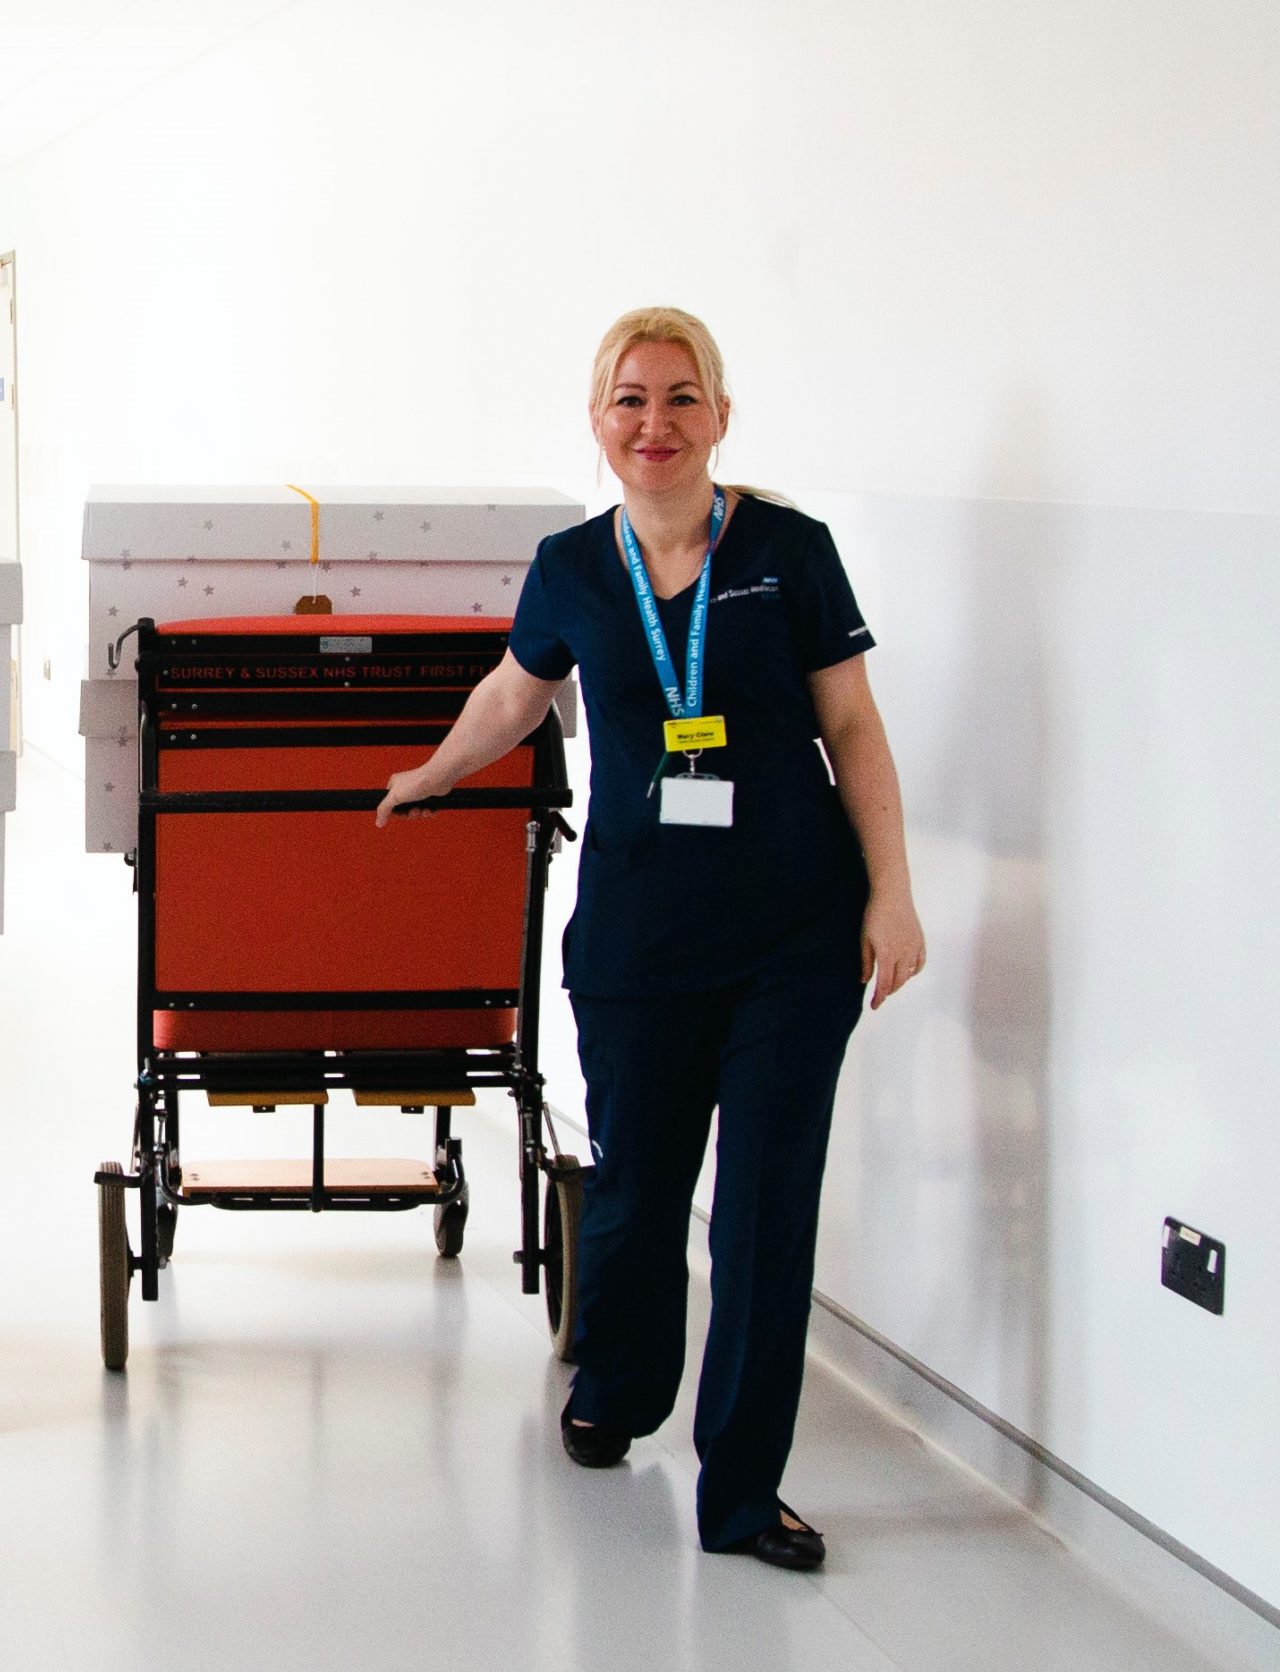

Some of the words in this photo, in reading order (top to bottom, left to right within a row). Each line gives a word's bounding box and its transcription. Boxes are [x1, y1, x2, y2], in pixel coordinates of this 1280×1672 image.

[627, 547, 641, 565] and
[632, 565, 648, 596] Family
[642, 596, 659, 628] Health
[690, 604, 706, 637] Family
[650, 629, 666, 662] Surrey
[690, 638, 700, 659] and
[170, 667, 235, 680] SURREY
[240, 667, 251, 679] &
[255, 667, 319, 680] SUSSEX
[323, 666, 356, 679] NHS
[362, 665, 412, 679] TRUST
[420, 665, 465, 678] FIRST
[687, 661, 699, 708] Children
[664, 686, 686, 717] NHS
